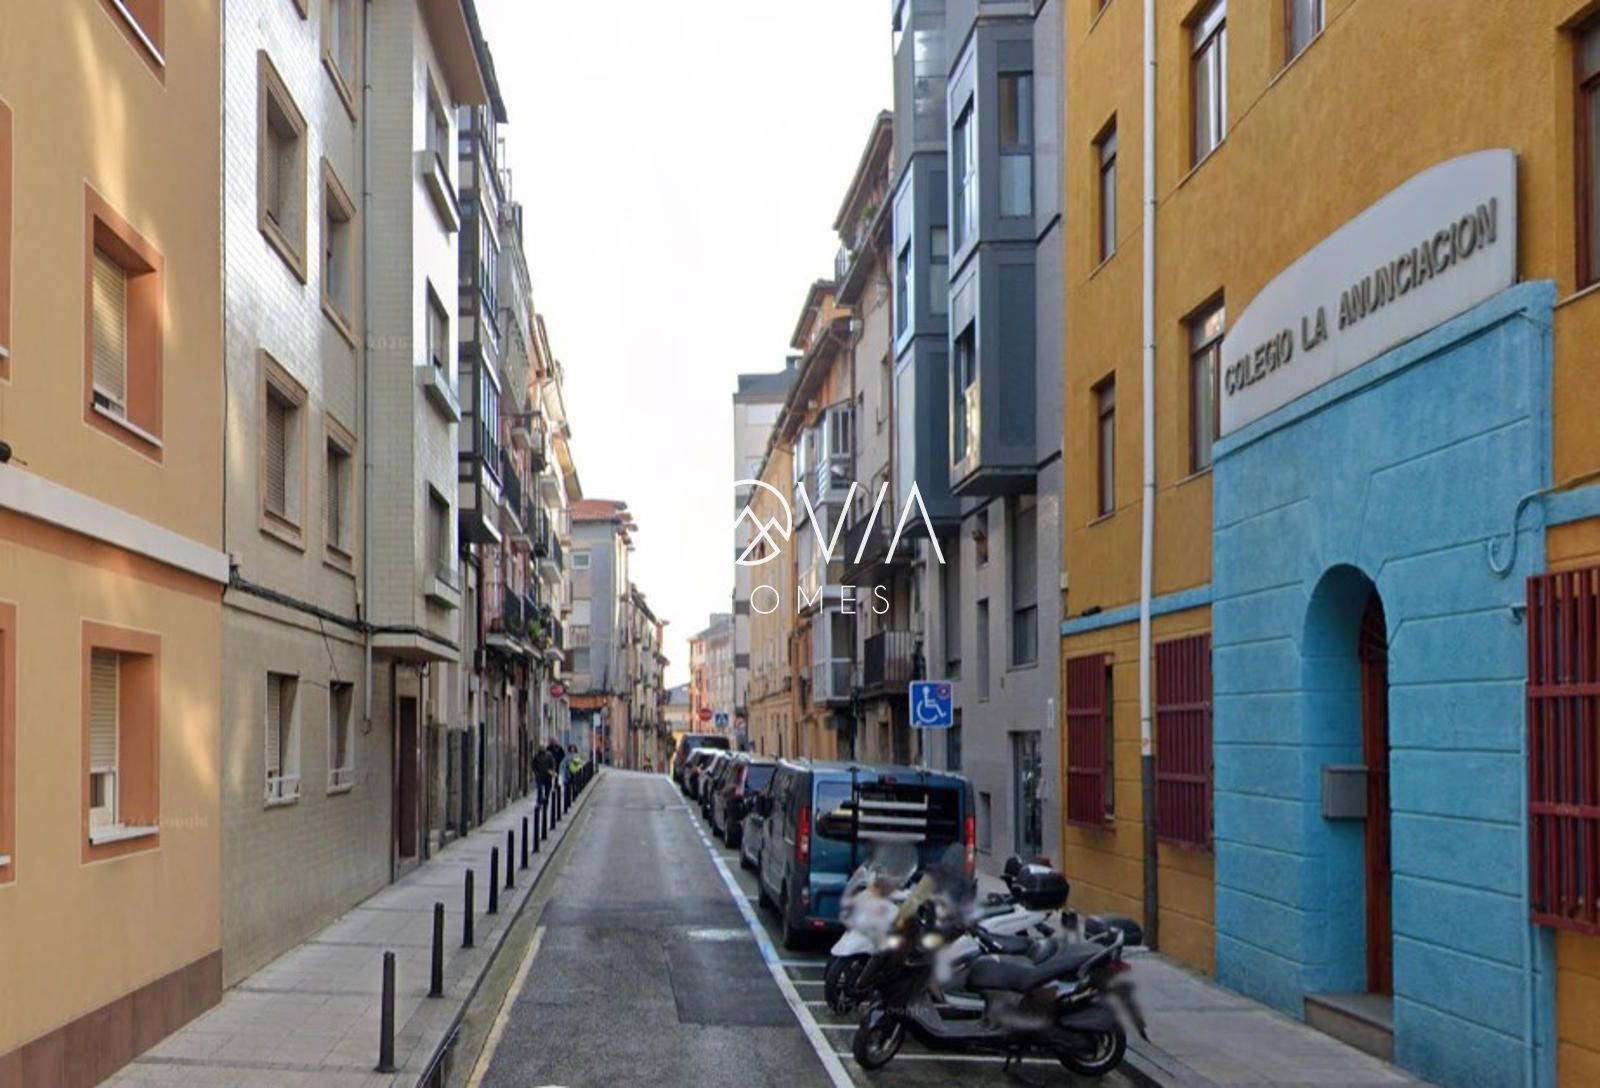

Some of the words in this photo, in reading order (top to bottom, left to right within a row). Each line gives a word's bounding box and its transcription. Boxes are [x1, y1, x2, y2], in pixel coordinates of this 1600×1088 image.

[1225, 330, 1293, 396] COLEGIO
[1301, 306, 1328, 352] LA
[1338, 197, 1497, 331] ANUNCIACION
